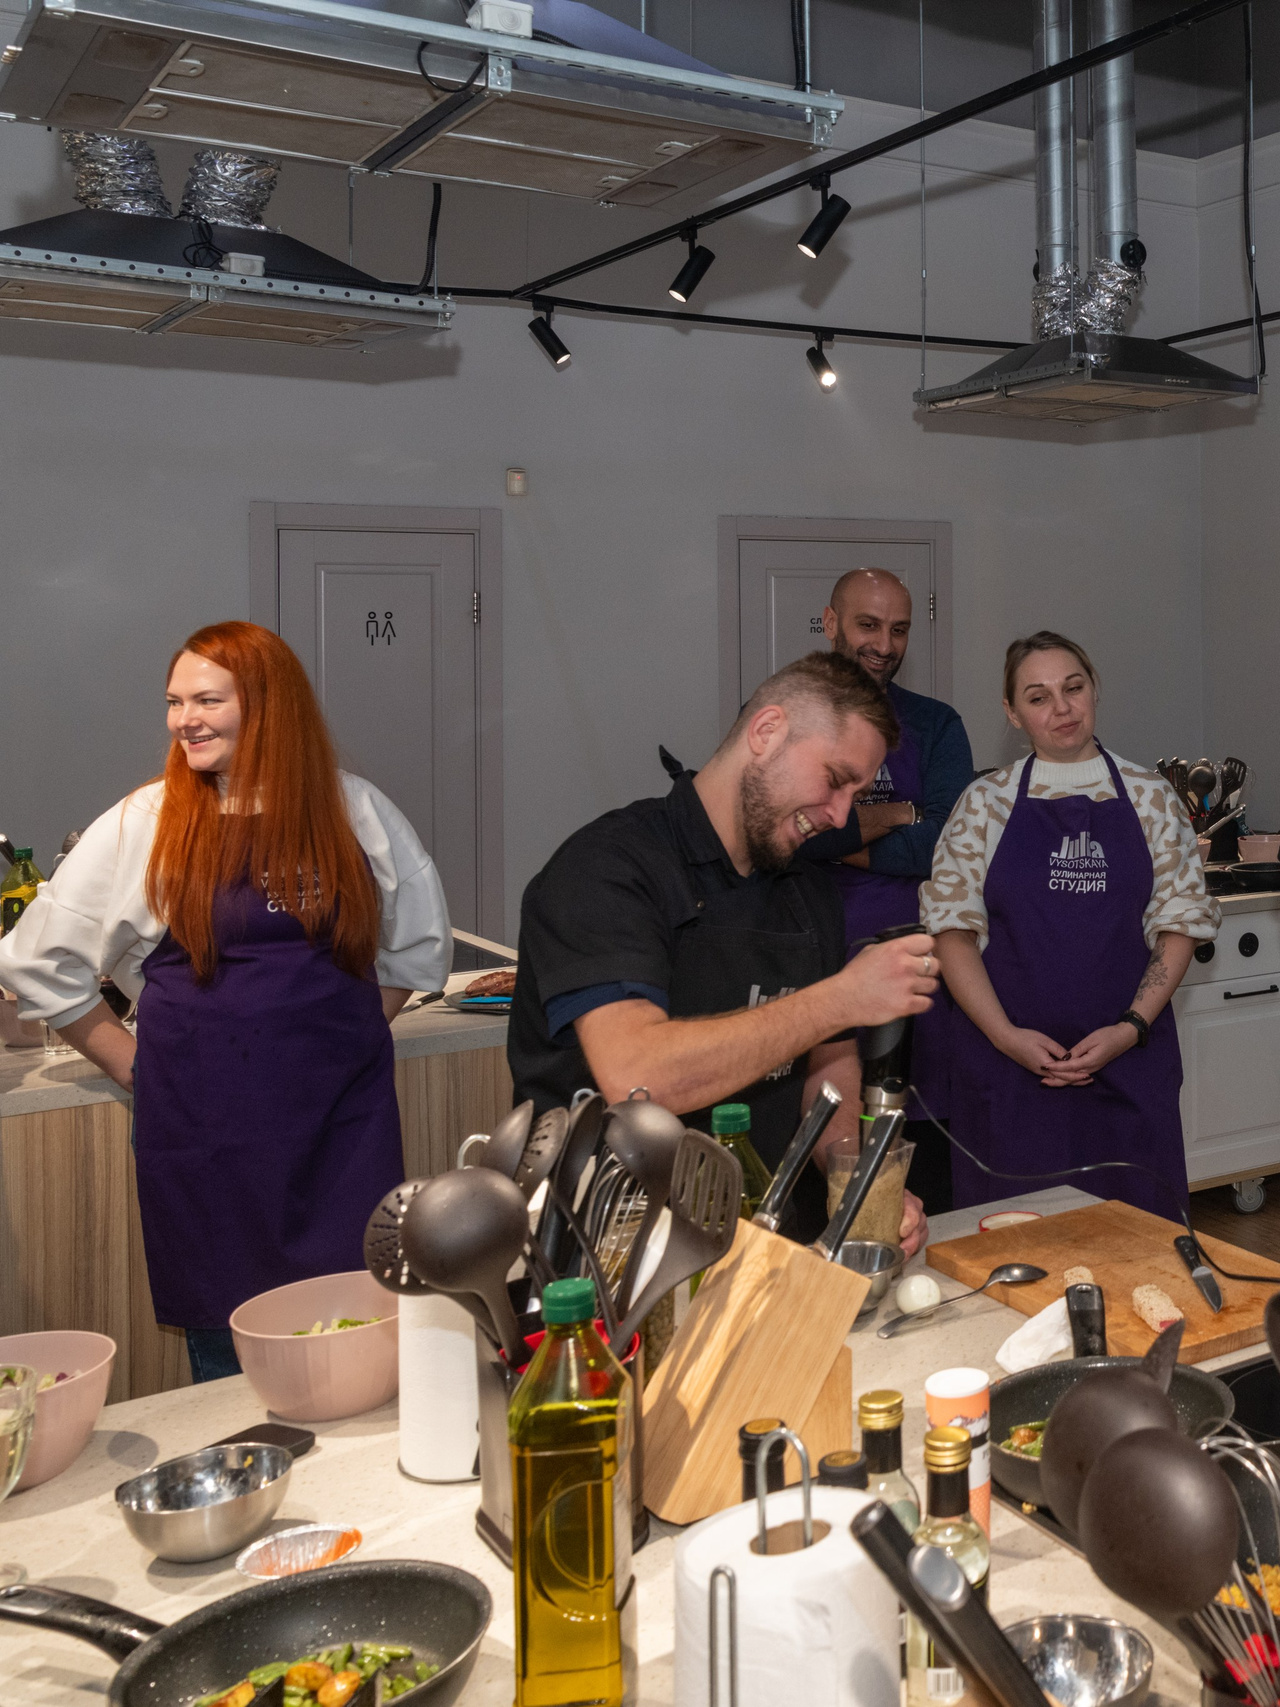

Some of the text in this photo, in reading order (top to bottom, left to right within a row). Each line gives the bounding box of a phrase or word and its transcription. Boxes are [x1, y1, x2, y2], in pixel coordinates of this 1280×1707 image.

[1050, 831, 1105, 859] Julia
[1049, 857, 1109, 869] VYSOTSKAYA
[1050, 869, 1107, 879] КУЛИНАРНАЯ
[1049, 878, 1106, 894] СТУДИЯ
